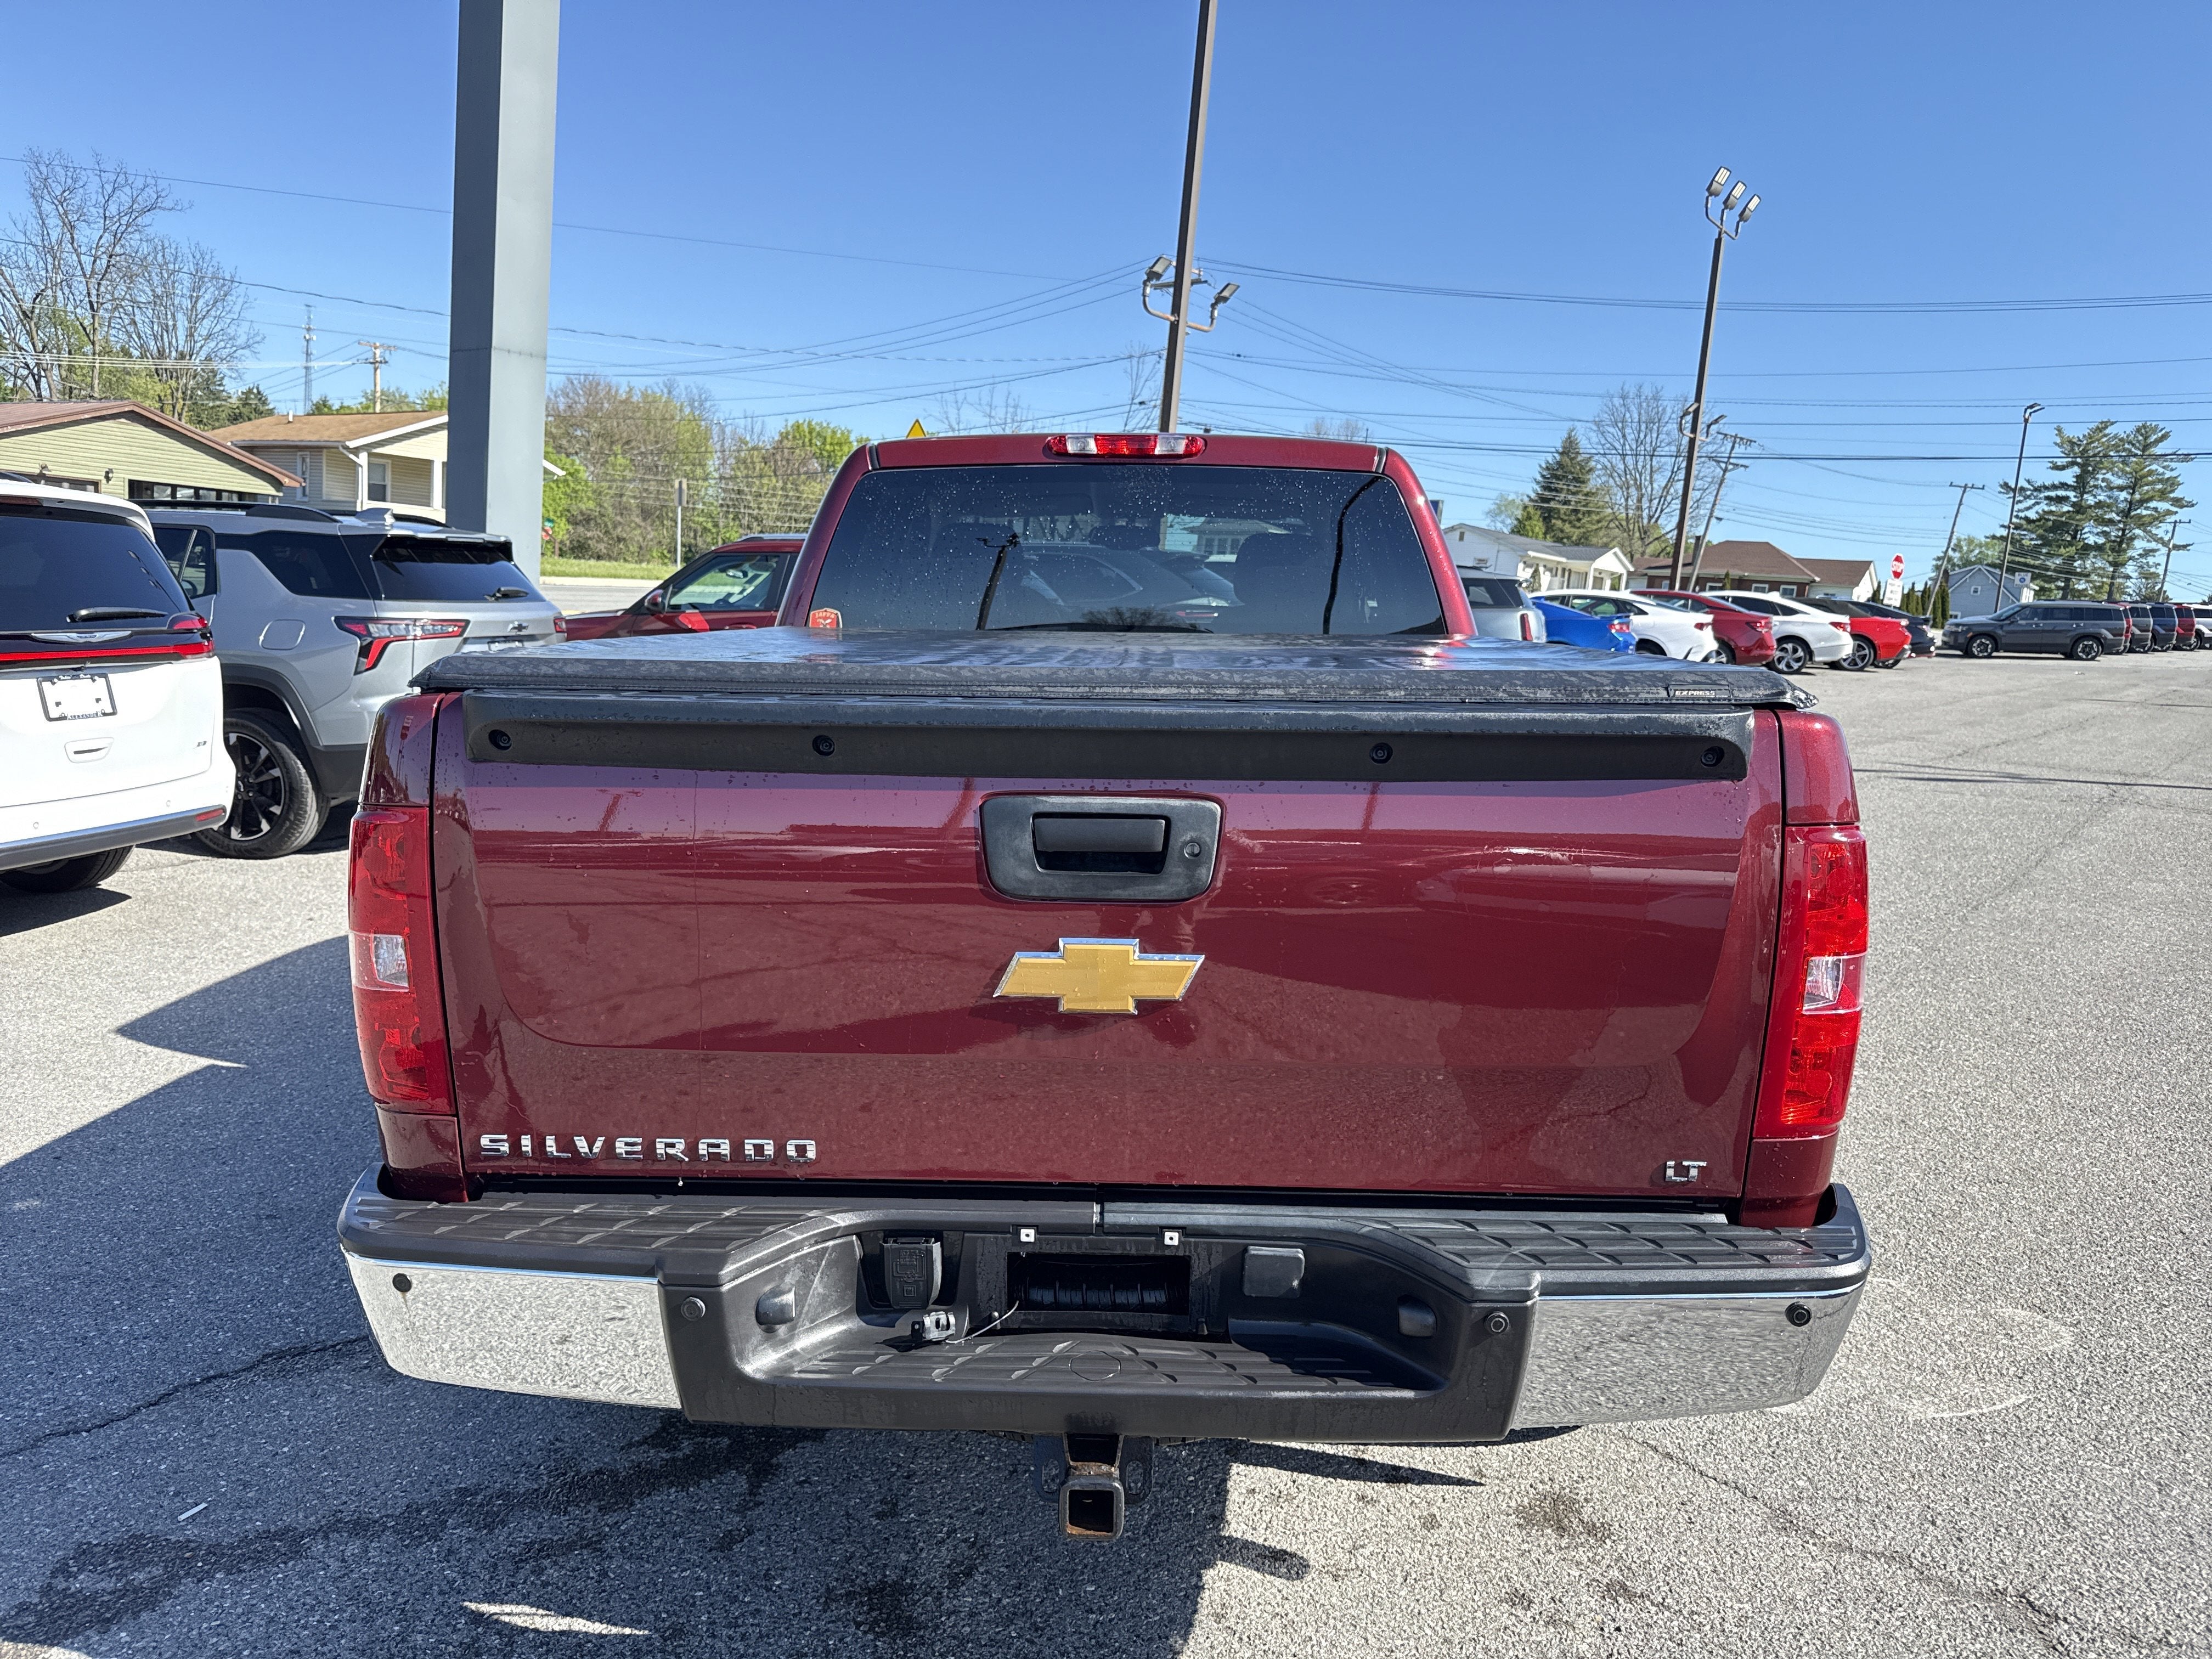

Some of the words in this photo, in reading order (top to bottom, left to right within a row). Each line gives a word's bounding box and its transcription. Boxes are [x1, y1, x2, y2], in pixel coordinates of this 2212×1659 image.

[1891, 561, 1903, 573] STOP
[66, 711, 103, 720] ALEXANDER
[481, 1134, 817, 1162] SILVERADO
[1666, 1160, 1707, 1182] LT
